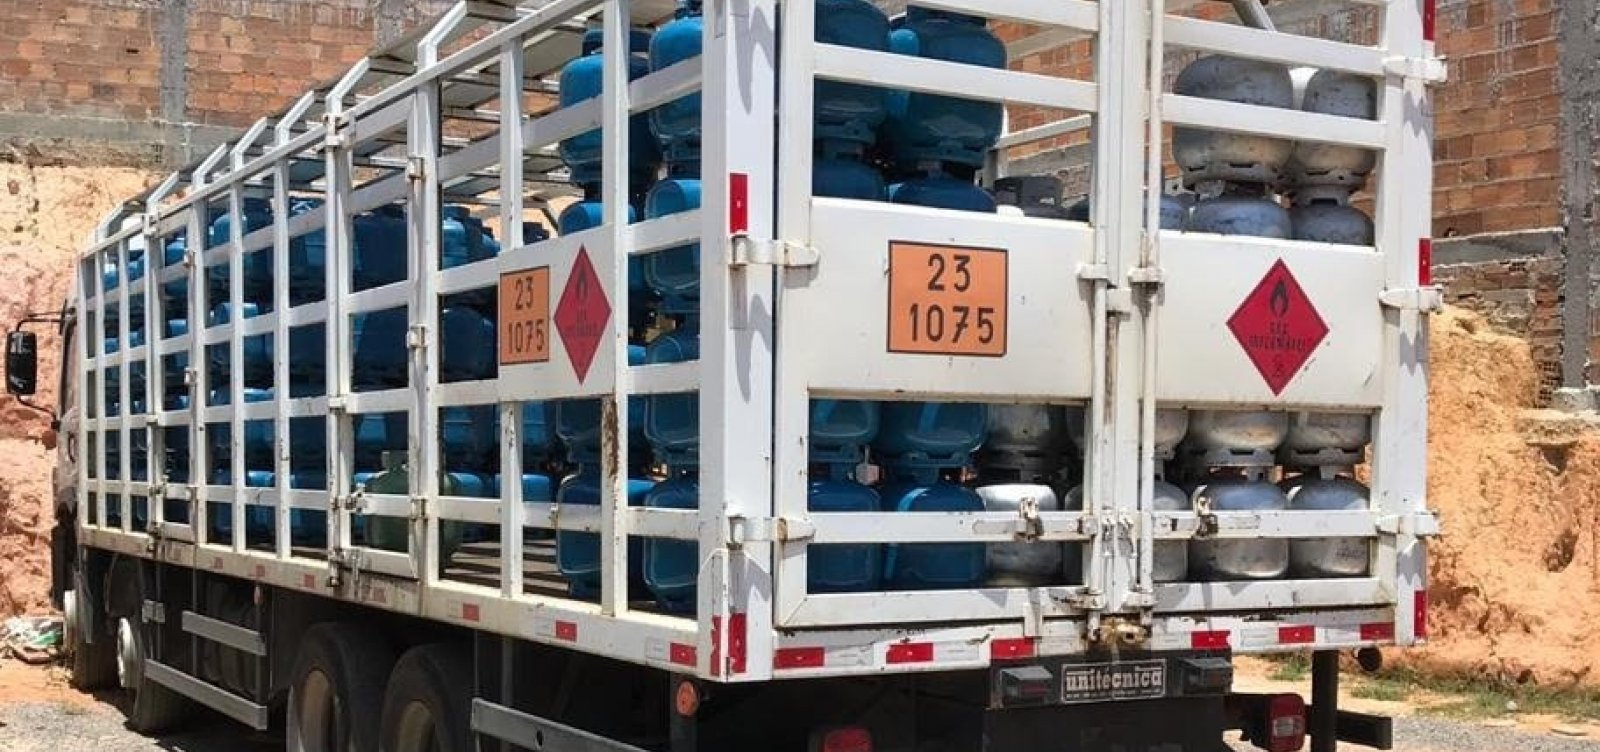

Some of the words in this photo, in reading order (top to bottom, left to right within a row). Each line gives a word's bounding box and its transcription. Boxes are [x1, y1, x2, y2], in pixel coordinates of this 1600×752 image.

[928, 253, 970, 292] 23
[515, 276, 533, 310] 23
[508, 319, 545, 354] 1075
[910, 303, 994, 343] 1075
